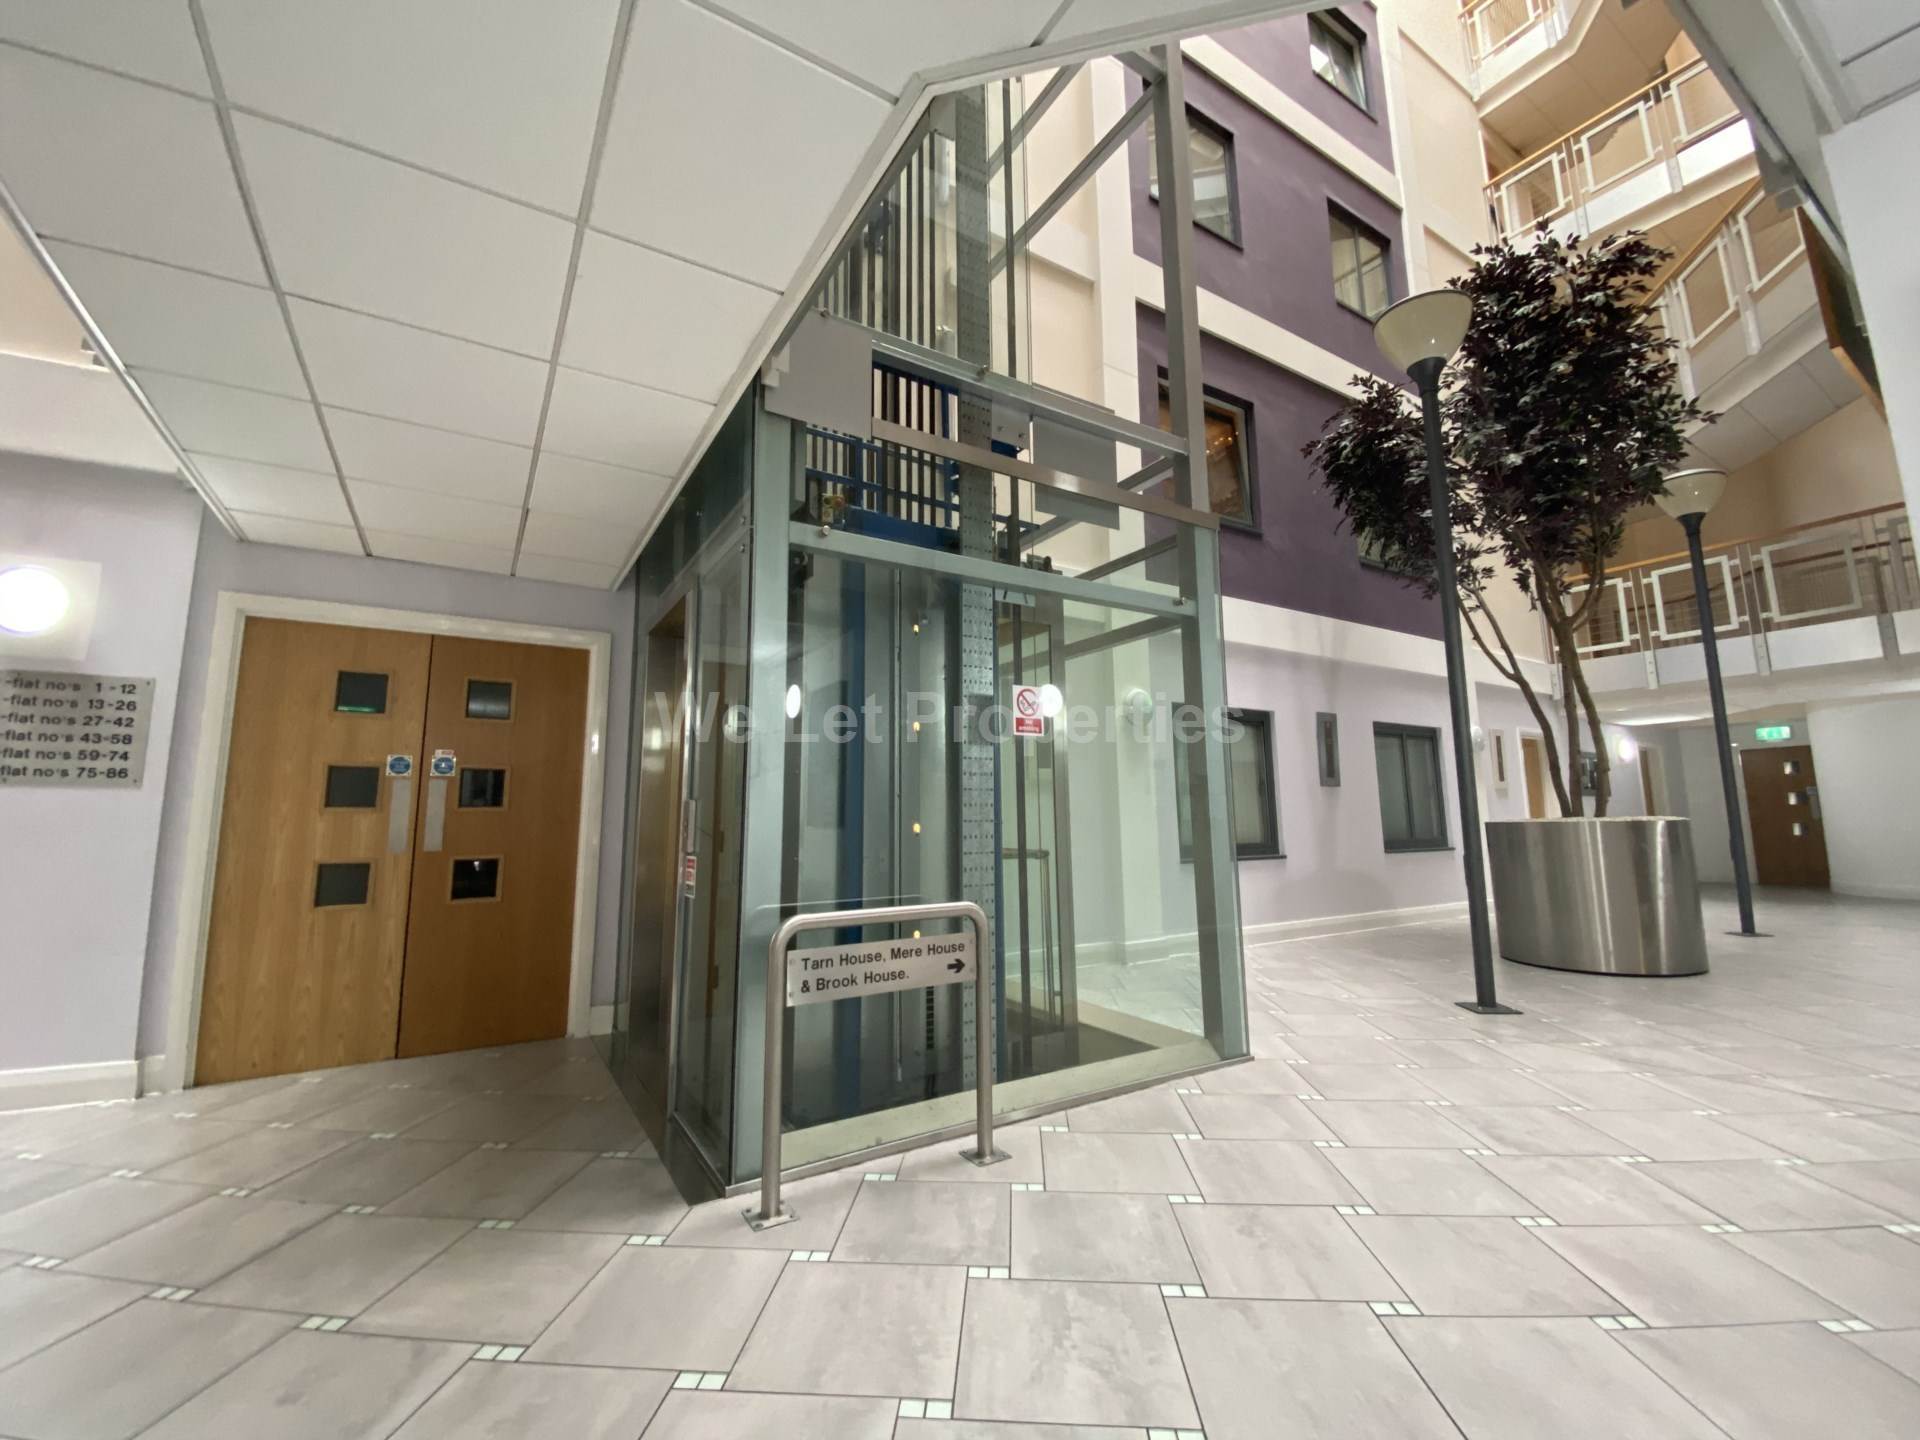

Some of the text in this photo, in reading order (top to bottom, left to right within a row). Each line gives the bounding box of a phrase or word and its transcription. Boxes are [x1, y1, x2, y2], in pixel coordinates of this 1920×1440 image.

[801, 942, 965, 971] Tarn House, Mere House
[801, 969, 910, 993] & Brook House.
